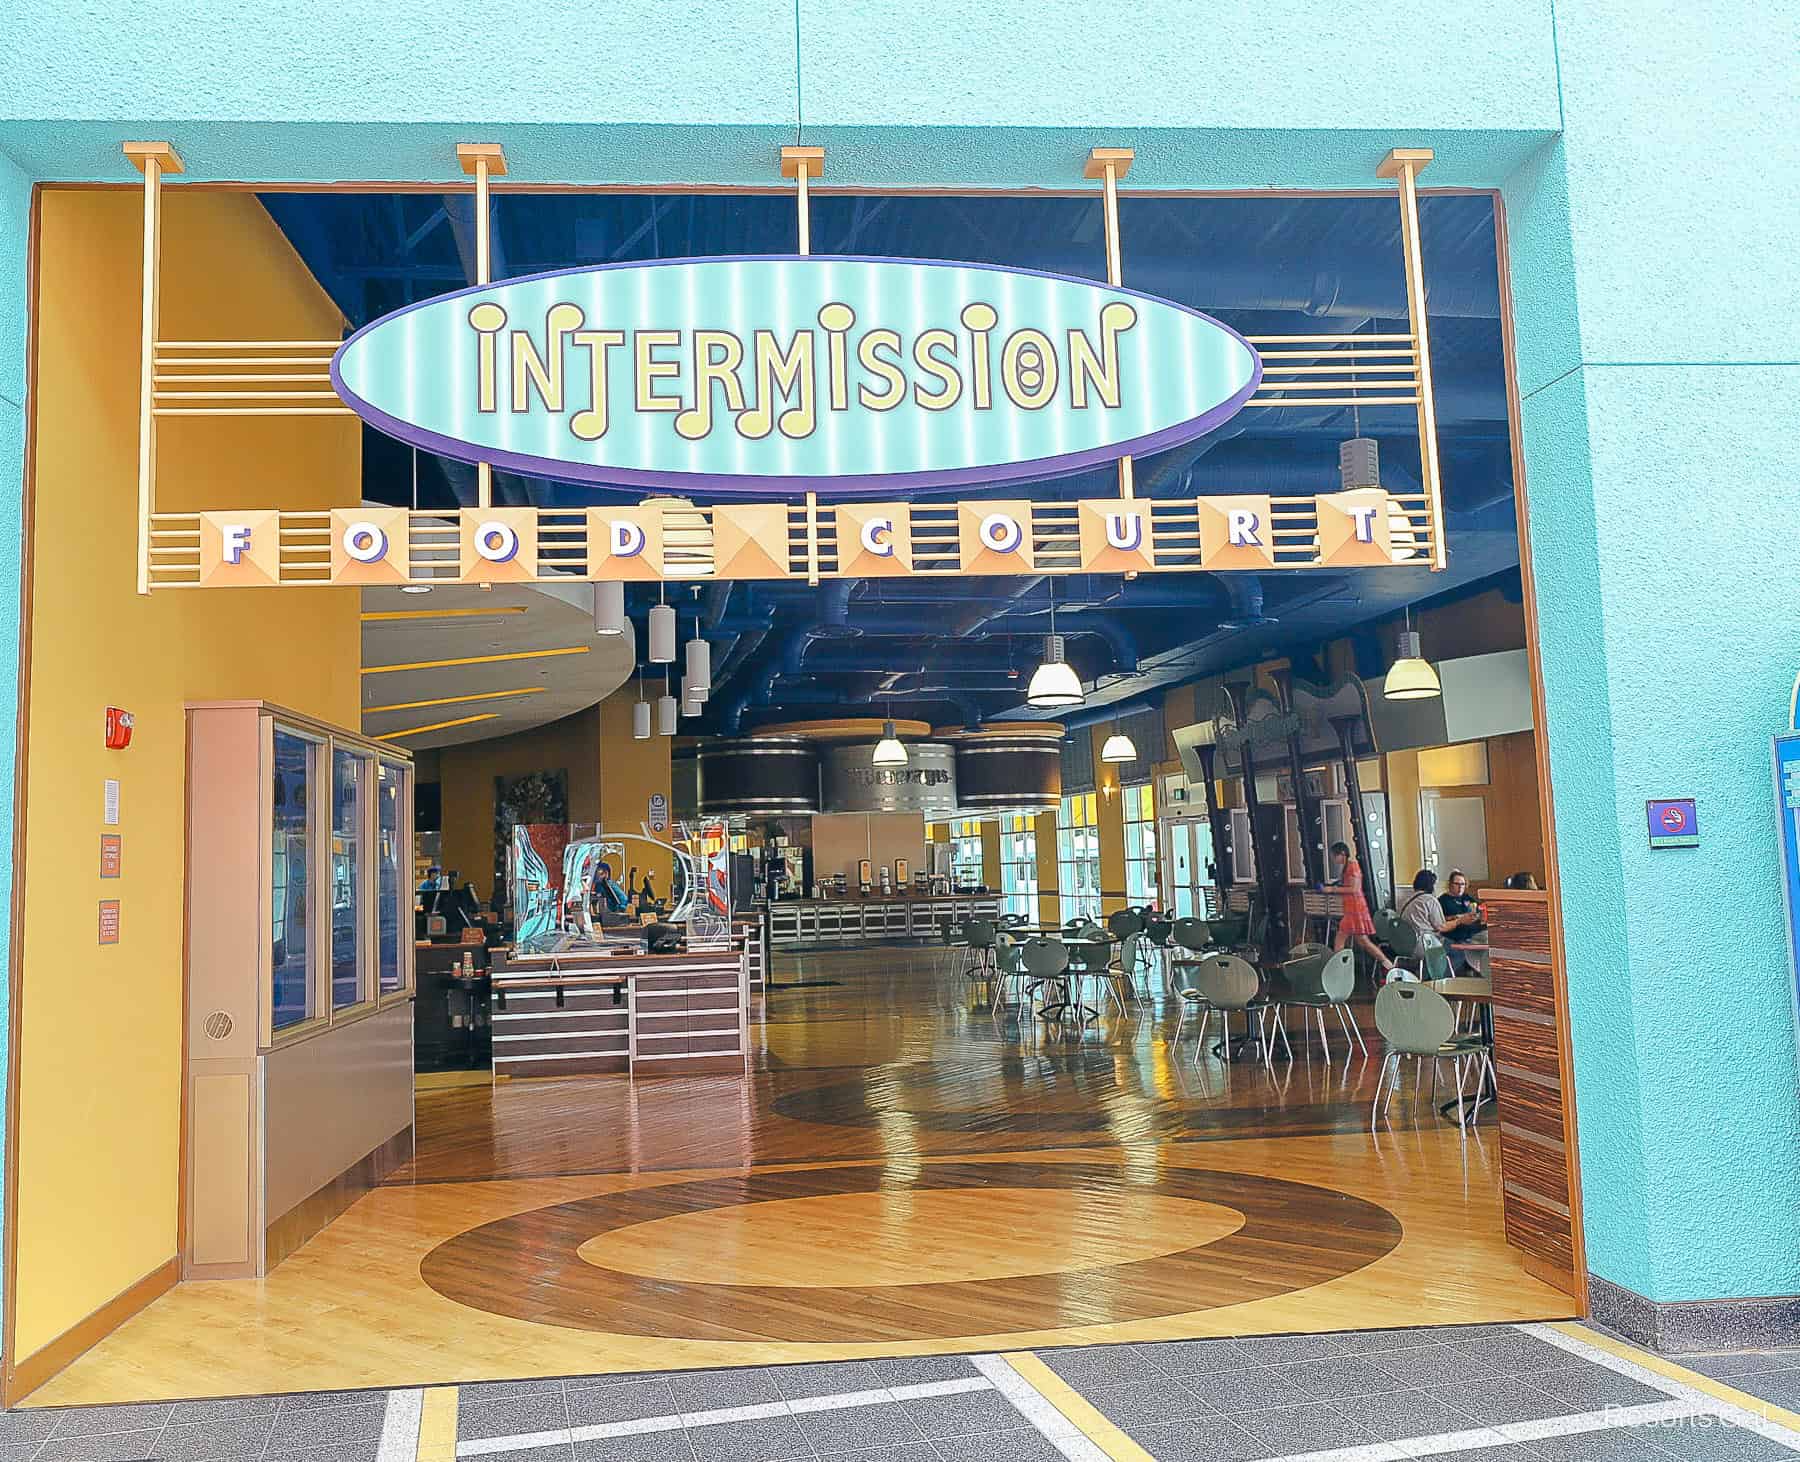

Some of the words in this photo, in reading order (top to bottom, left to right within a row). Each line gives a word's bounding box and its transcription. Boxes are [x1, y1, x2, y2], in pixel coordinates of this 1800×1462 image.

[468, 302, 1138, 441] INTERMISSION
[222, 521, 645, 564] FOOD
[860, 507, 1377, 556] COURT
